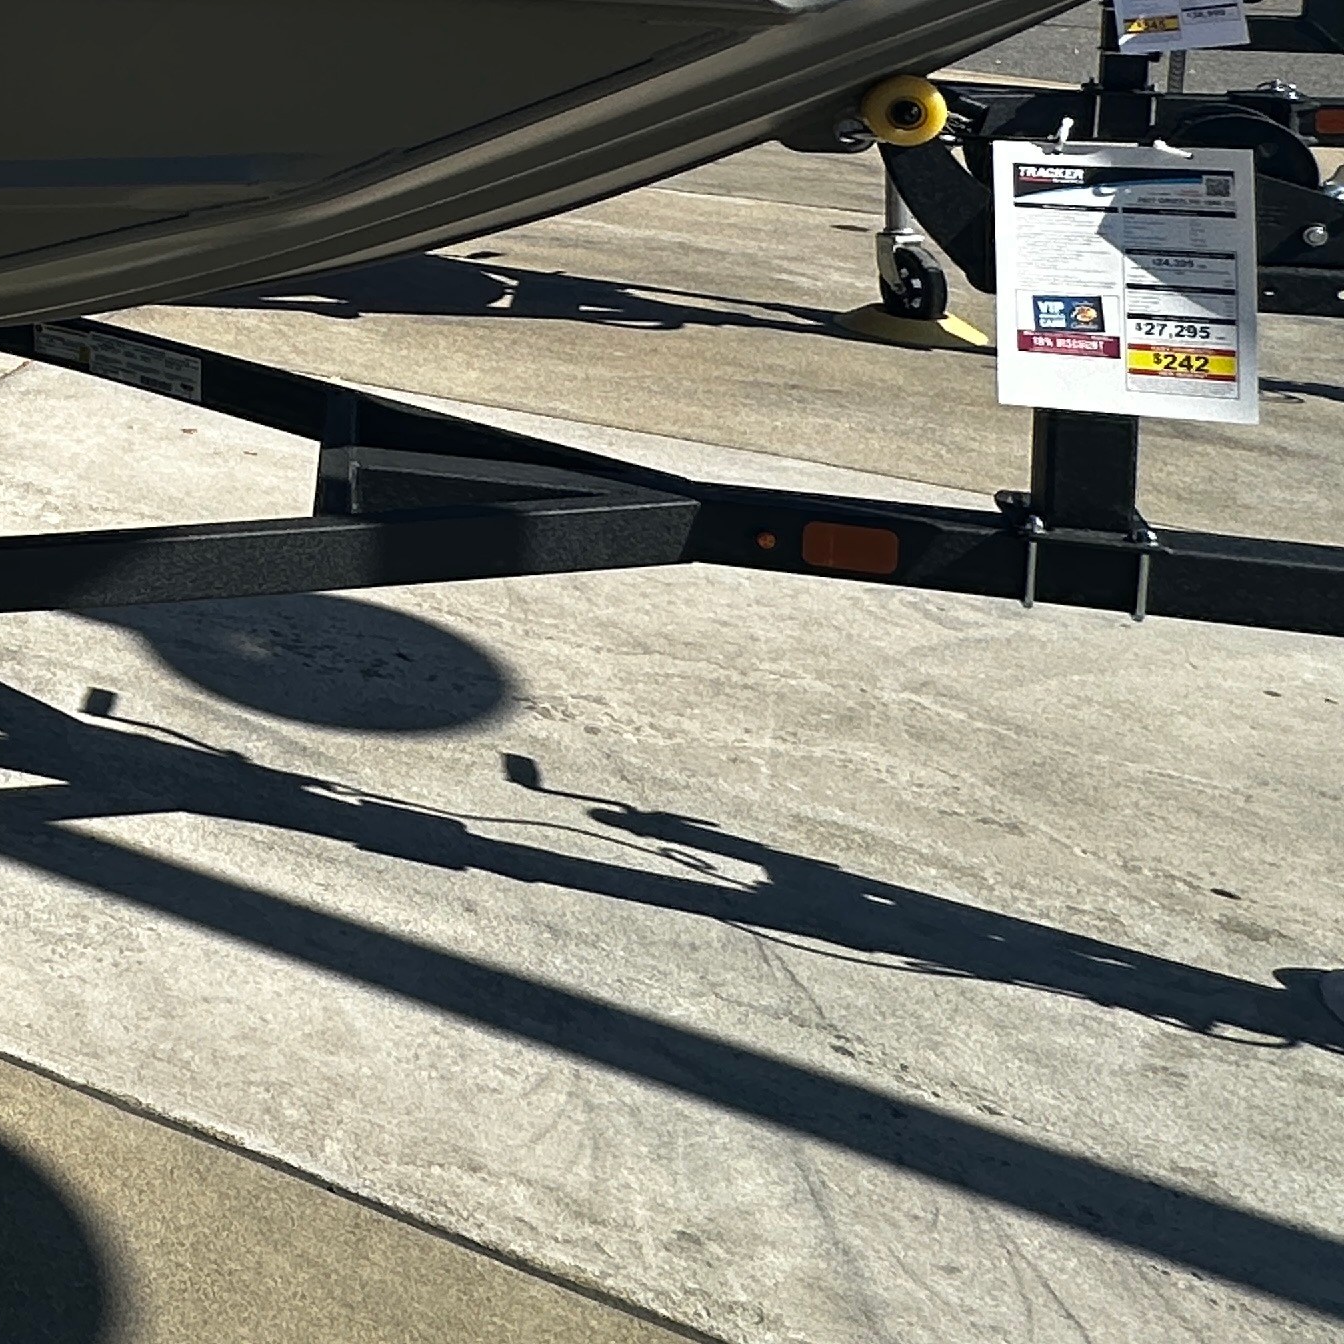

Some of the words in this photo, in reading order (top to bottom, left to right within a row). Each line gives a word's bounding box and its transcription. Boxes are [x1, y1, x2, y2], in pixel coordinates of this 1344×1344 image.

[1018, 166, 1085, 180] TRACKER
[1135, 322, 1211, 340] $27,295
[1153, 352, 1210, 373] $242
